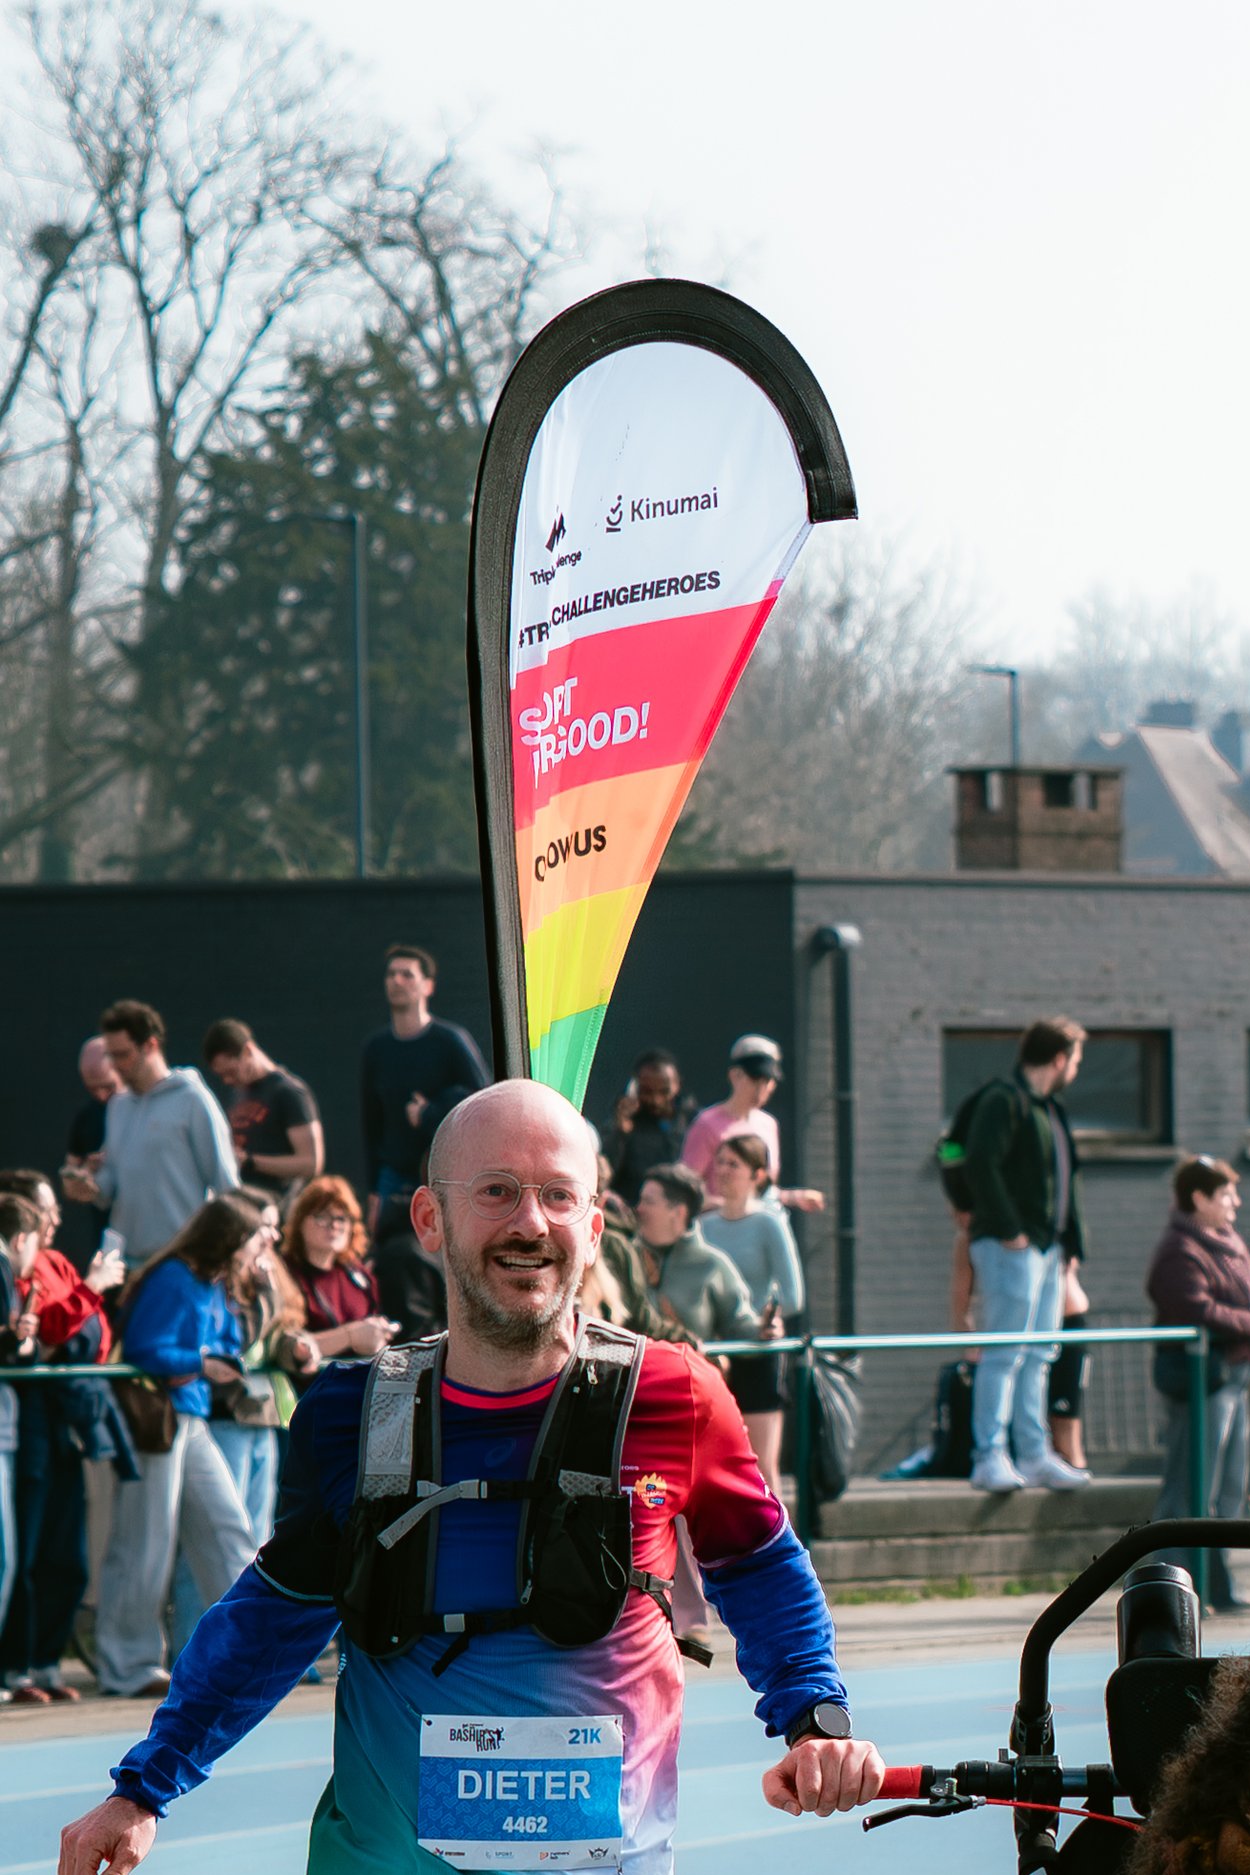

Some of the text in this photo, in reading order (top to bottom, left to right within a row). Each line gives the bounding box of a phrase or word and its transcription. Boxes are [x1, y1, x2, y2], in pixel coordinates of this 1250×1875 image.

[630, 487, 718, 522] Kinumai
[568, 1728, 602, 1744] 21K
[457, 1769, 591, 1800] DIETER
[502, 1816, 548, 1833] 4462
